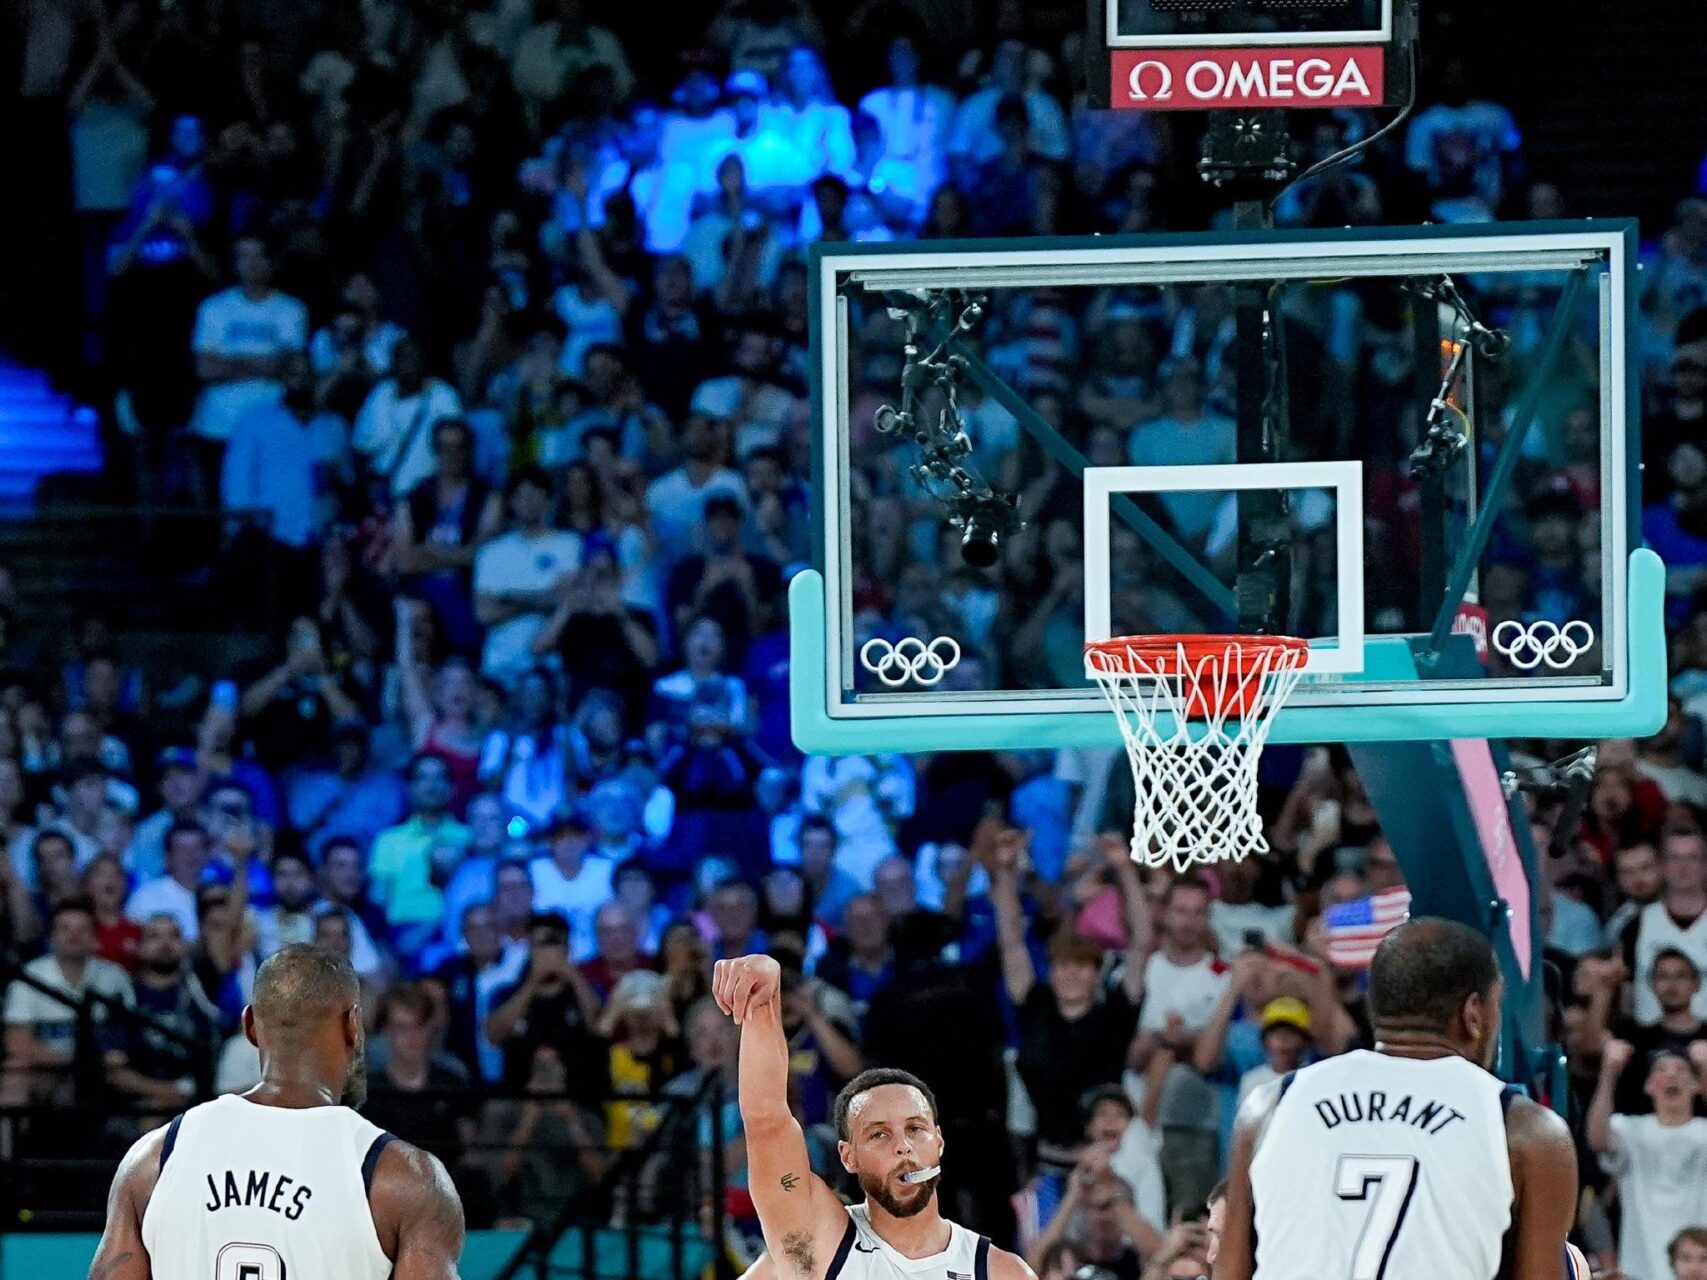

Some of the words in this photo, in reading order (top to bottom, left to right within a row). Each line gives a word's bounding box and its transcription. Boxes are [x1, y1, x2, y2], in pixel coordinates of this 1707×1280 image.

[1185, 57, 1371, 99] OMEGA
[1314, 1090, 1467, 1135] DURANT
[206, 1169, 313, 1221] JAMES
